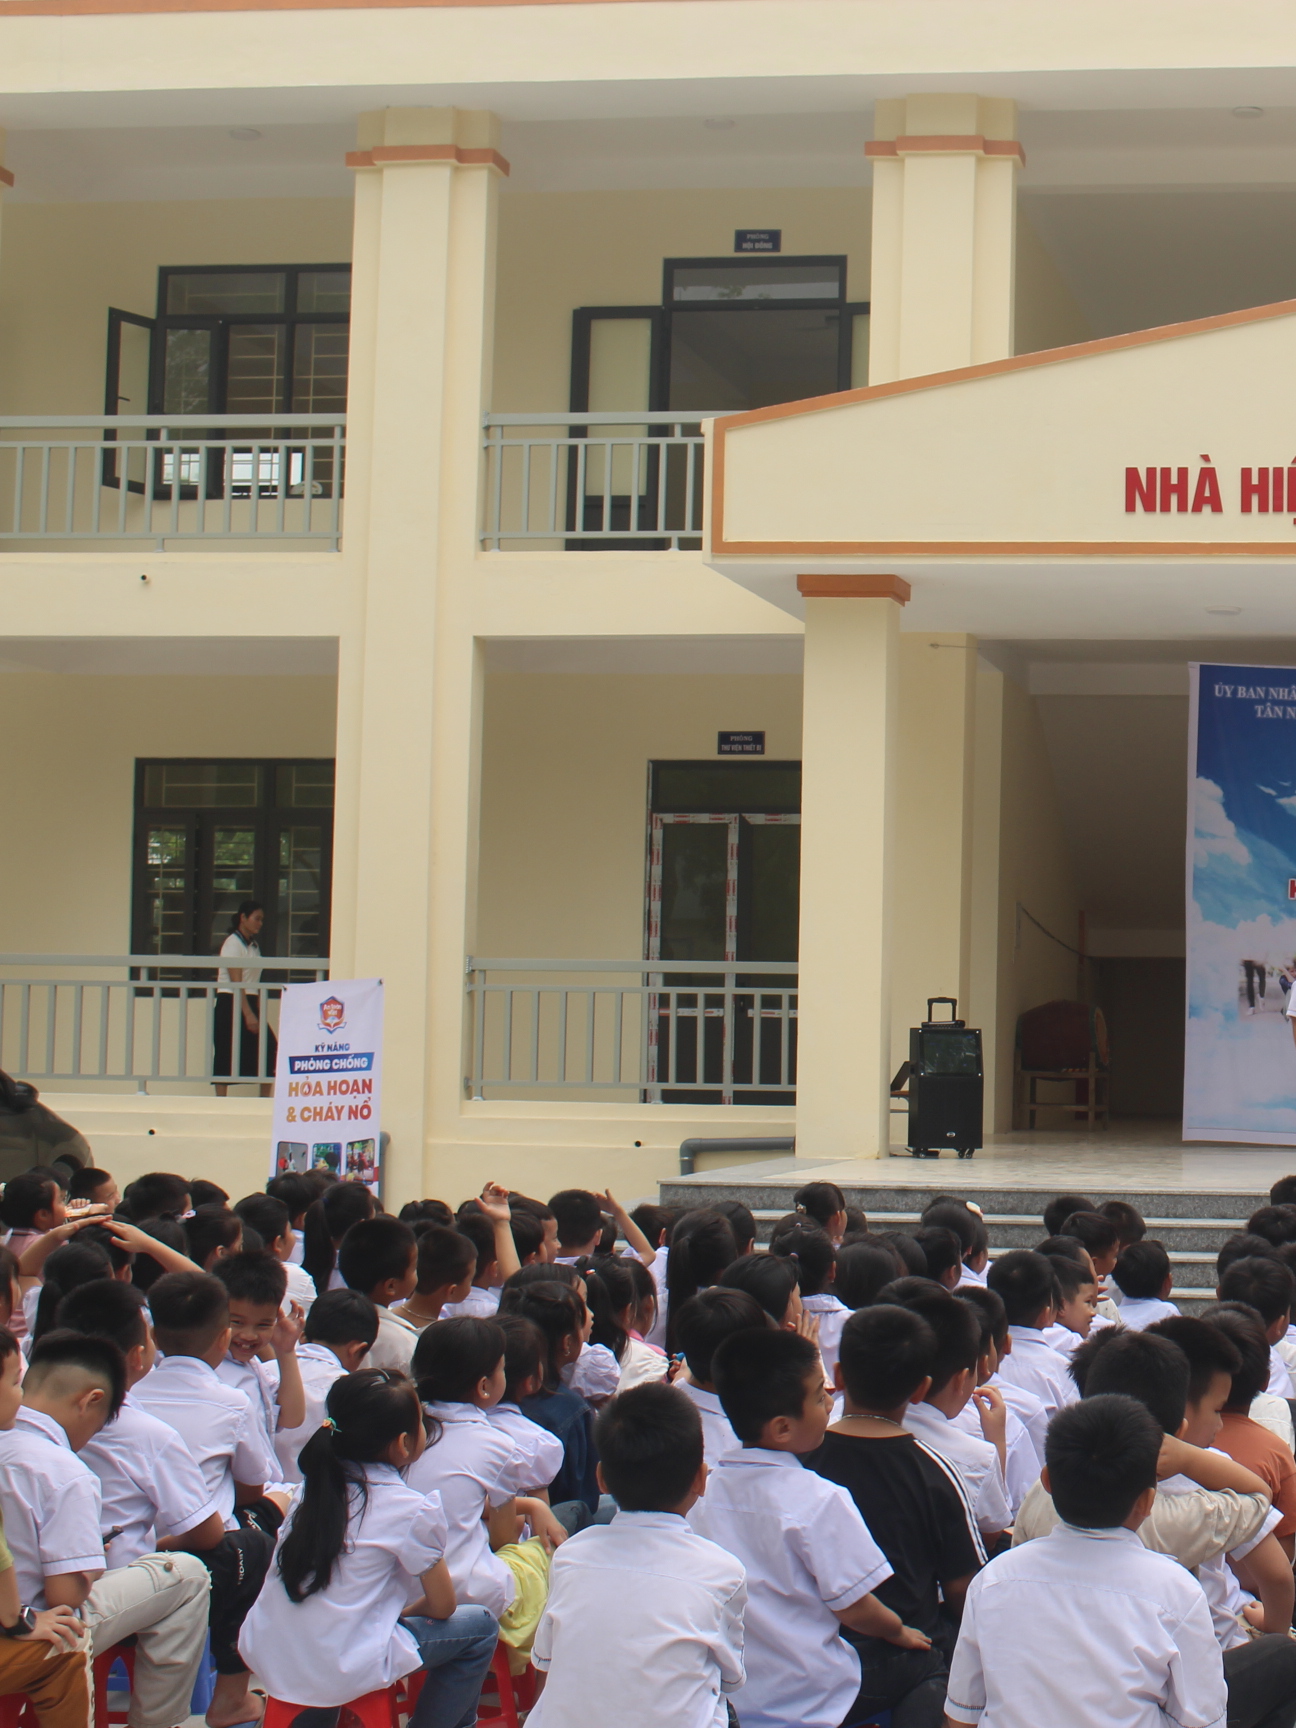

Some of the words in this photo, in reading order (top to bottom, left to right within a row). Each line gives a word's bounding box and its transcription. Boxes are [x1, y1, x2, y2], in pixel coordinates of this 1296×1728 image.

[1126, 455, 1222, 512] NHÀ
[1214, 682, 1234, 698] ỦY
[1237, 686, 1266, 699] BAN
[1254, 702, 1284, 719] TÂN
[314, 1042, 326, 1053] KỸ
[327, 1041, 351, 1052] NĂNG
[294, 1056, 331, 1072] PHÒNG
[332, 1053, 369, 1071] CHỐNG
[288, 1075, 325, 1098] HỎA
[326, 1078, 373, 1100] HOẠN
[286, 1106, 297, 1123] &
[299, 1101, 345, 1122] CHÁY
[347, 1097, 373, 1121] NỔ
